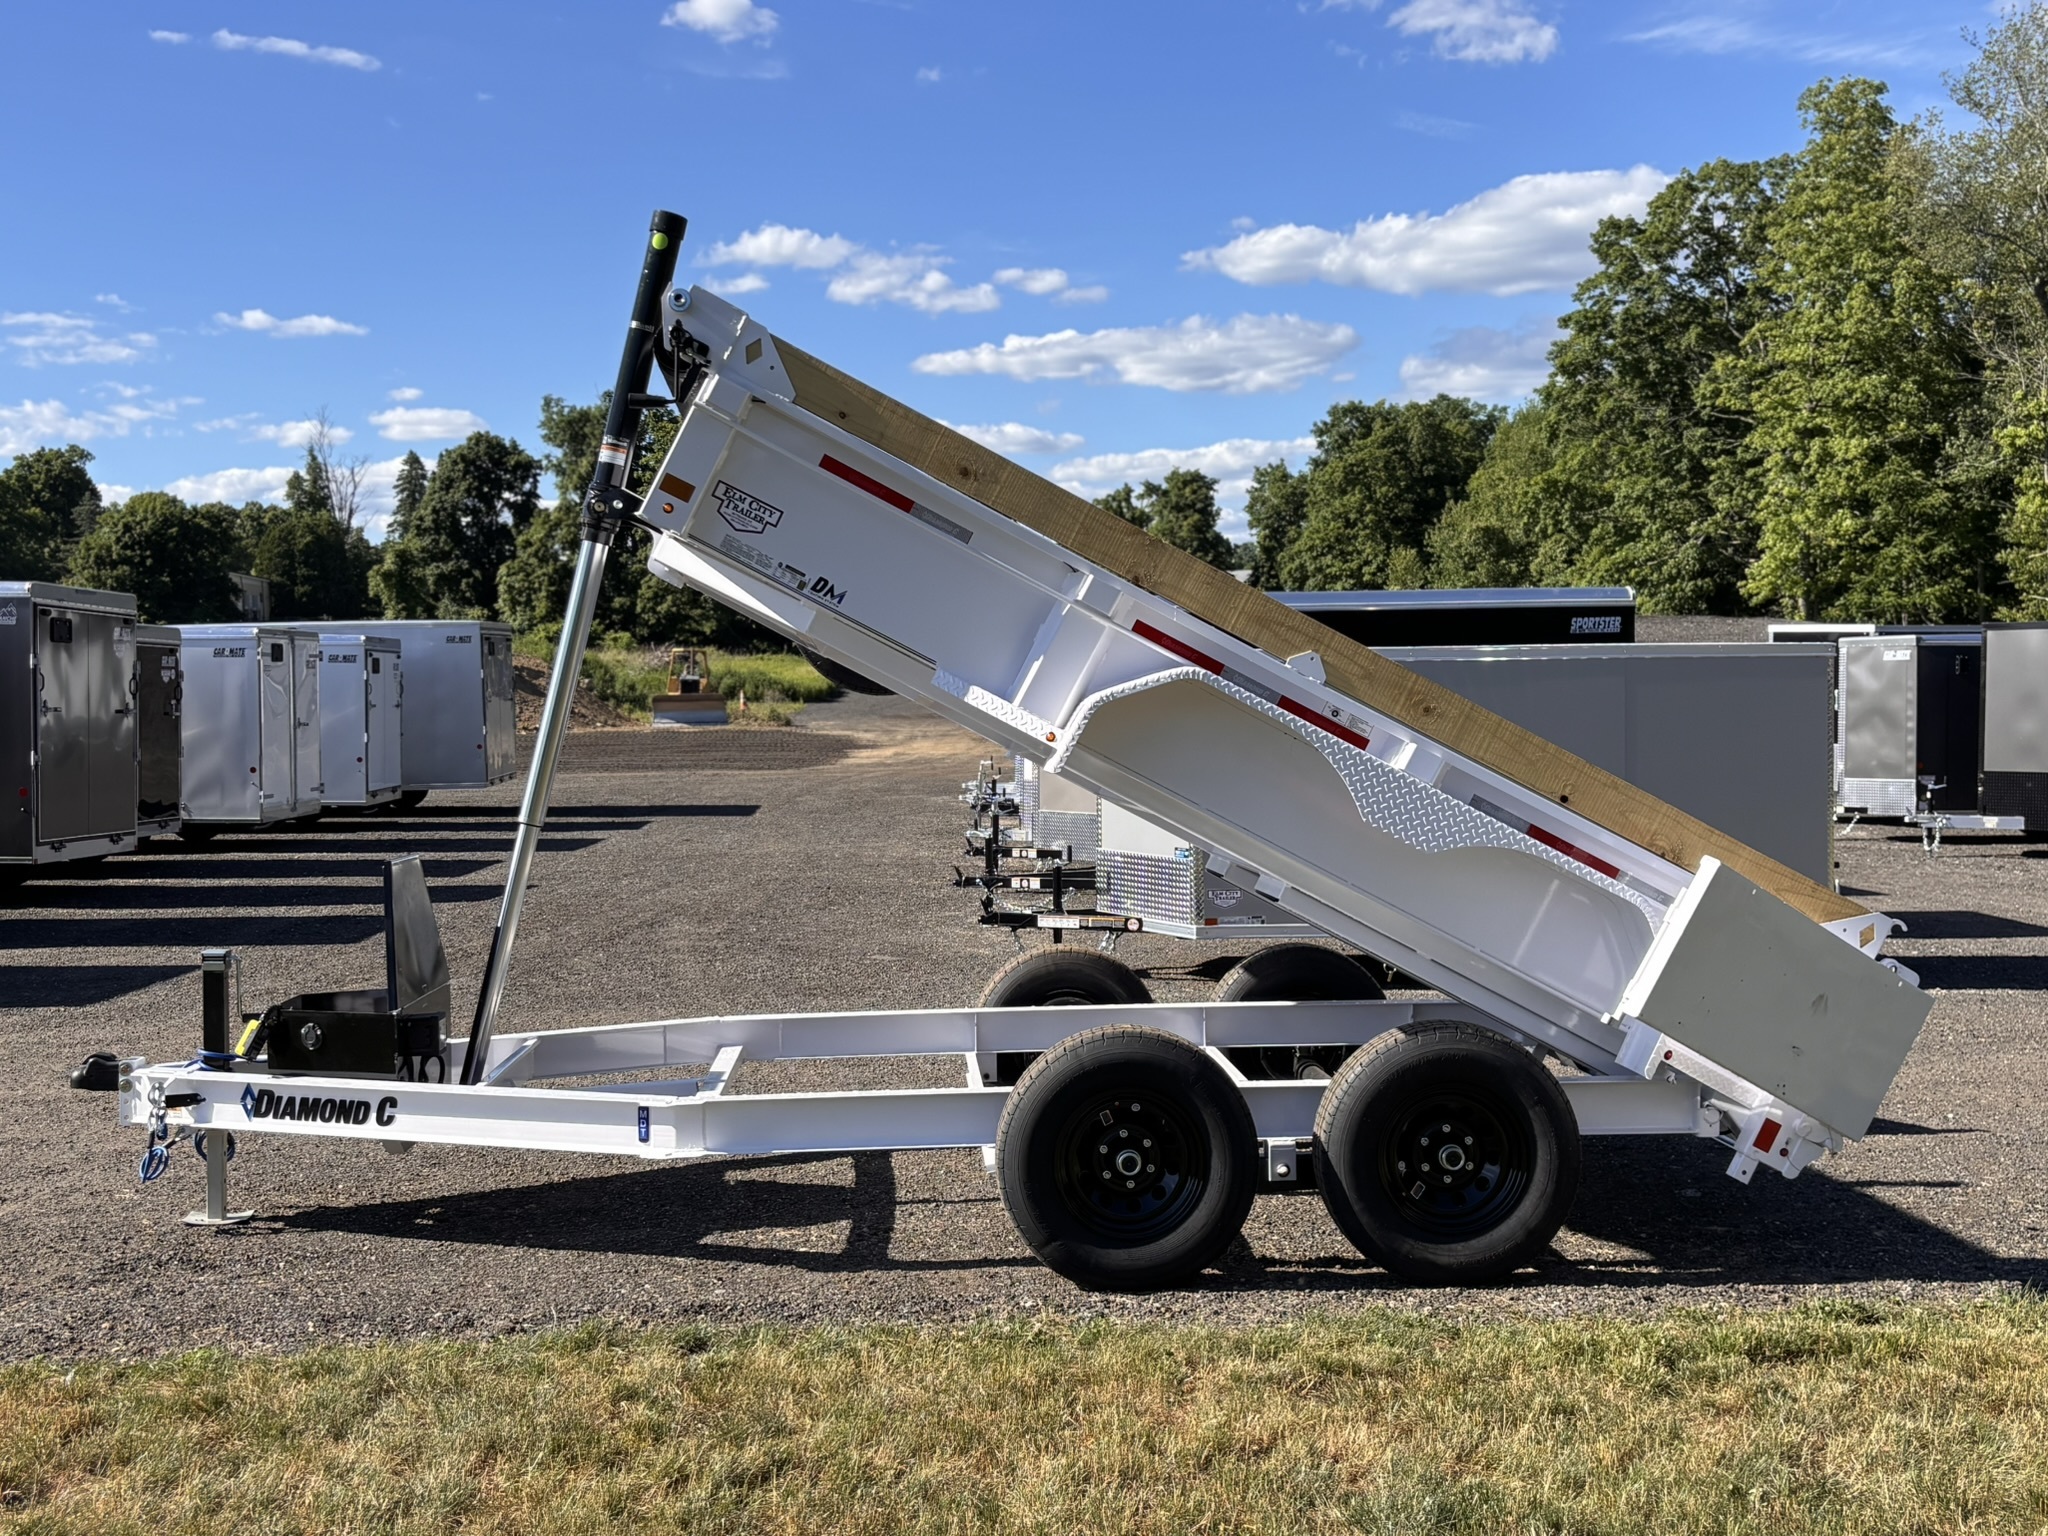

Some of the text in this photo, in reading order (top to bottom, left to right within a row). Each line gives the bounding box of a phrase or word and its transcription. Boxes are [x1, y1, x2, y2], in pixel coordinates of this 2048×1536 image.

[722, 486, 776, 519] ELM CITY
[724, 496, 766, 525] TRAILER
[810, 576, 848, 604] DM
[1571, 616, 1622, 630] SPORTSTER
[253, 1089, 398, 1127] DIAMOND C
[639, 1109, 648, 1138] MDT
